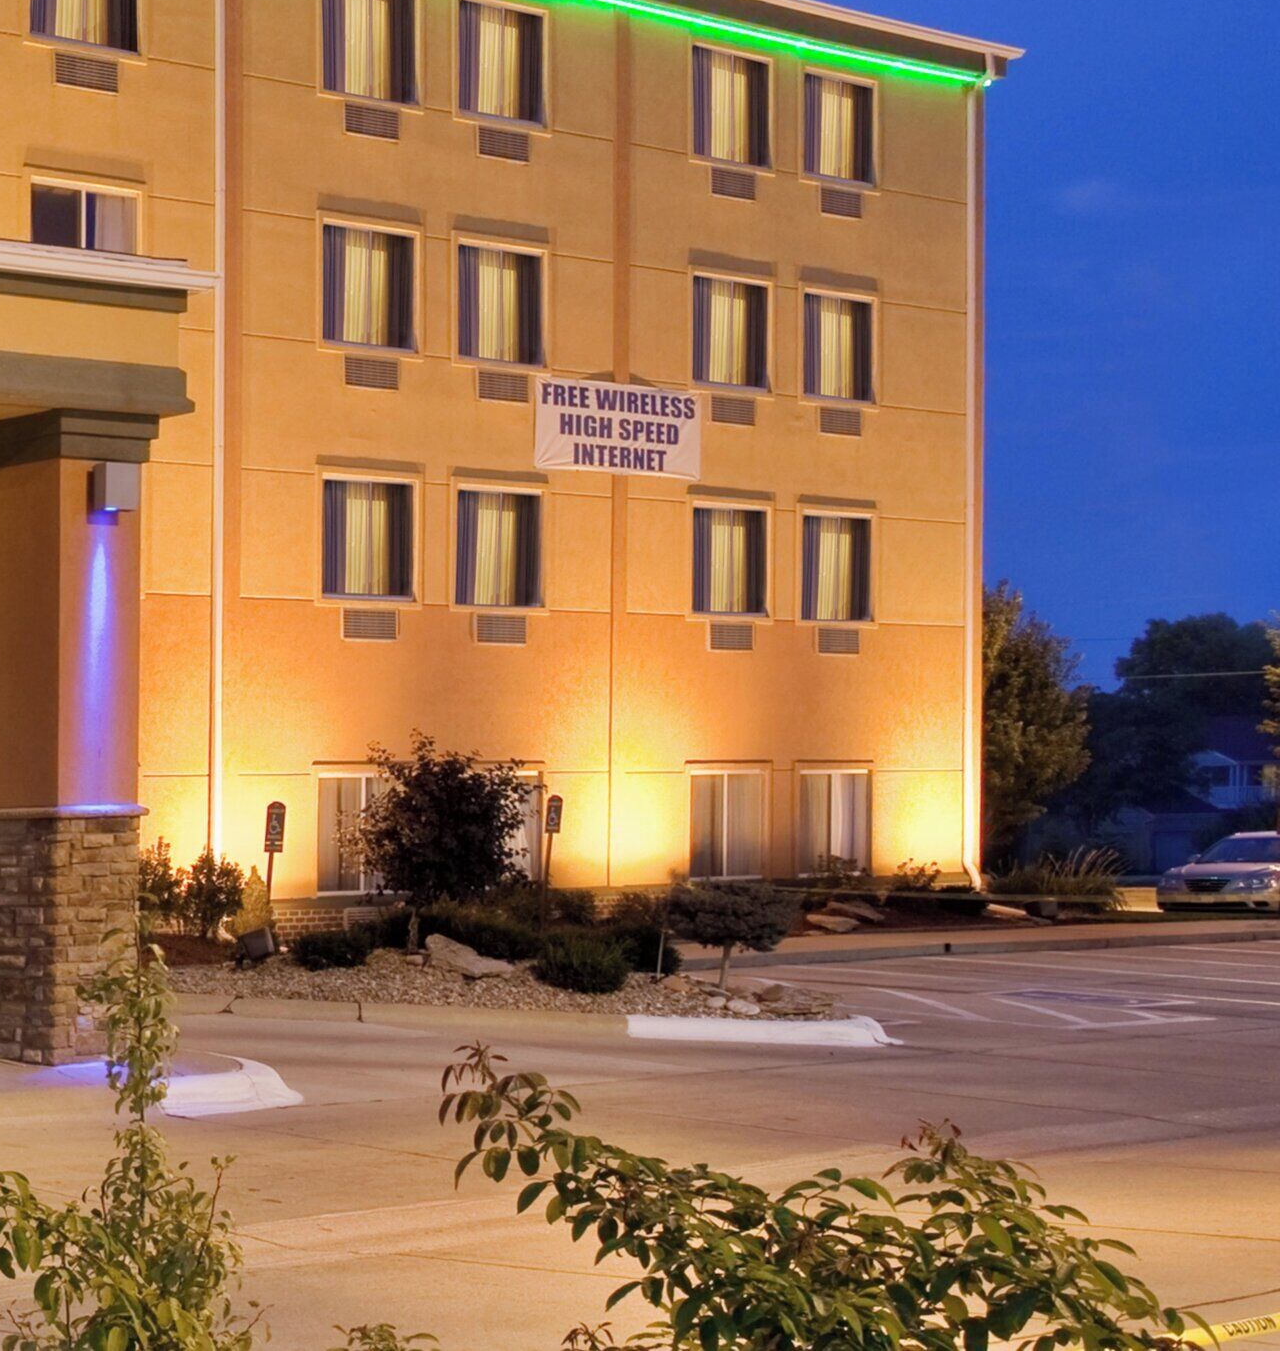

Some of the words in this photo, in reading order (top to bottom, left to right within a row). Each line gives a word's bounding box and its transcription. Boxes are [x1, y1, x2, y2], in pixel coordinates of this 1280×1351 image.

[541, 382, 590, 409] FREE
[595, 388, 696, 420] WIRELESS
[559, 413, 612, 439] HIGH
[618, 418, 679, 446] SPEED
[573, 442, 667, 472] INTERNET
[1222, 1315, 1277, 1337] CAUTION
